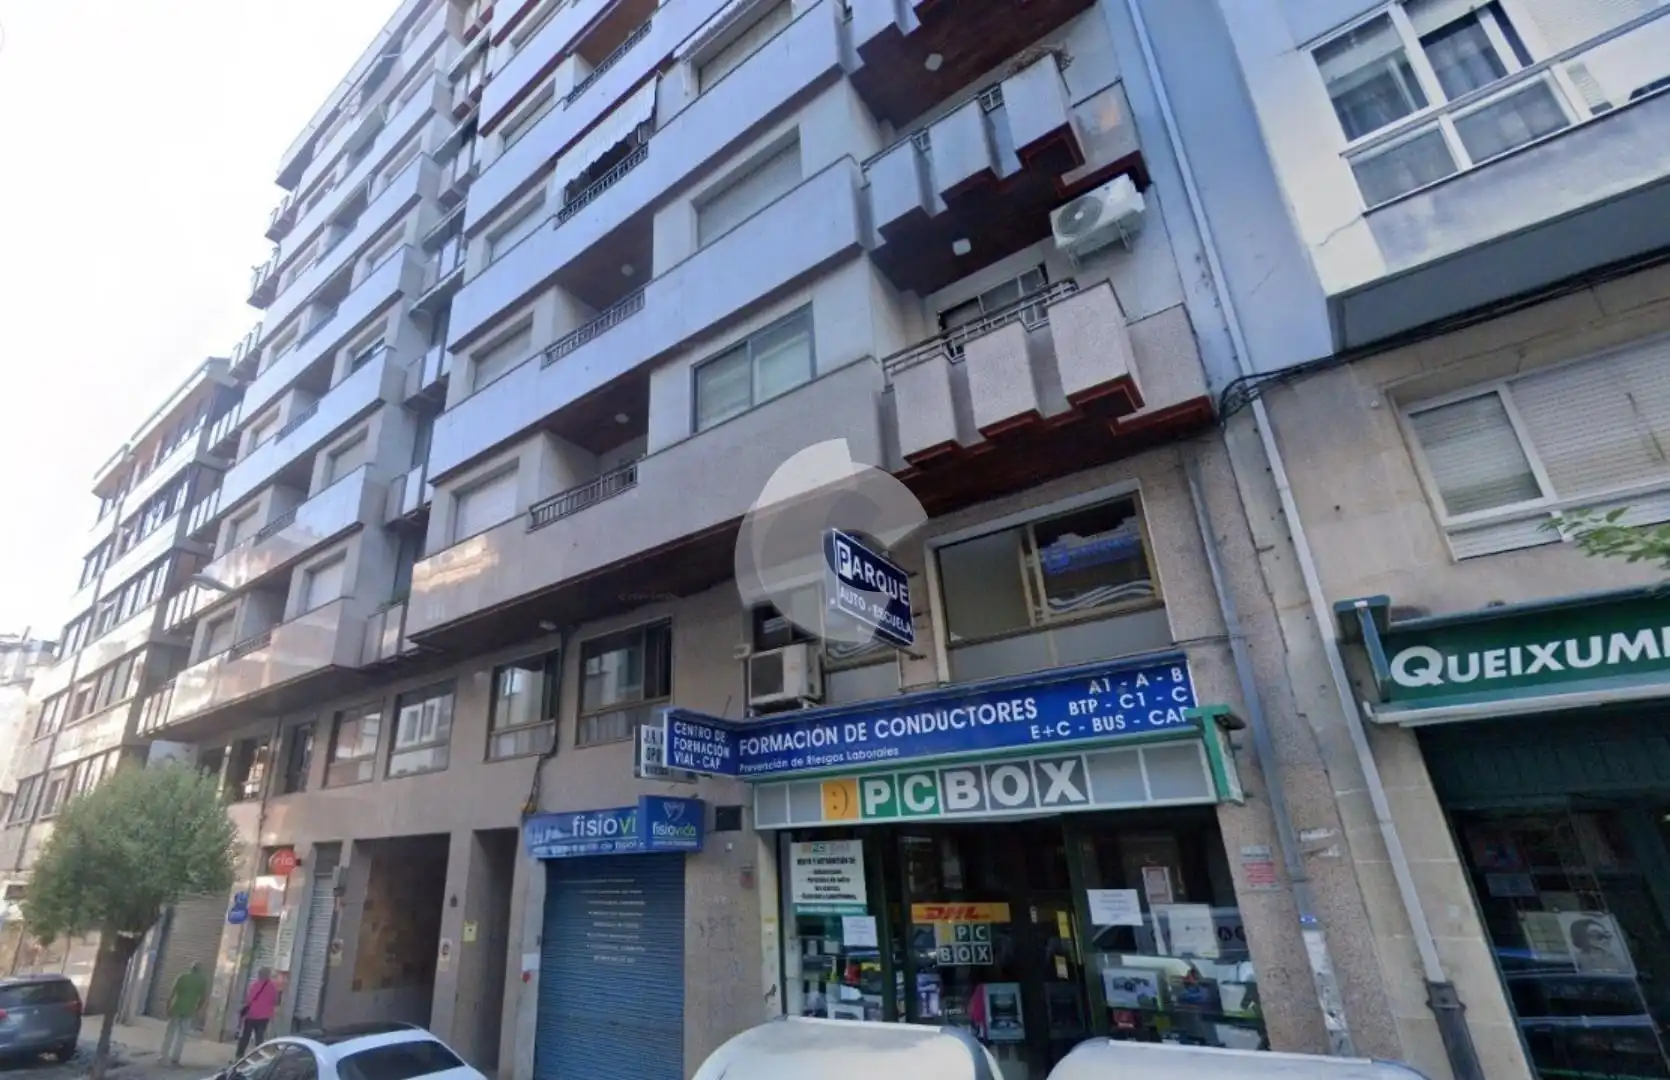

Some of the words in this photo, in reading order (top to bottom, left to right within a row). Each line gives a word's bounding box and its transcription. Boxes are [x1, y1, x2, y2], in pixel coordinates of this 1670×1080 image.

[837, 540, 910, 607] PARQUE
[840, 586, 867, 611] AUTO
[1089, 678, 1111, 695] A1
[1136, 672, 1149, 688] A
[1171, 667, 1184, 683] B
[1068, 698, 1098, 716] BTP
[1119, 692, 1146, 709] C1
[1172, 686, 1188, 702] C
[674, 721, 712, 740] CENTRO
[739, 724, 838, 756] FORMACIÓN
[845, 722, 868, 743] DE
[874, 697, 1038, 738] CONDUCTORES
[1030, 720, 1071, 740] E+C
[1092, 714, 1126, 733] BUS
[673, 750, 695, 767] VIAL
[790, 757, 804, 766] de
[806, 751, 844, 766] Riesgos
[846, 746, 899, 760] Laborales
[571, 810, 637, 837] fisiovi
[924, 907, 979, 919] DHL
[957, 926, 987, 940] PC
[941, 946, 988, 961] BOX
